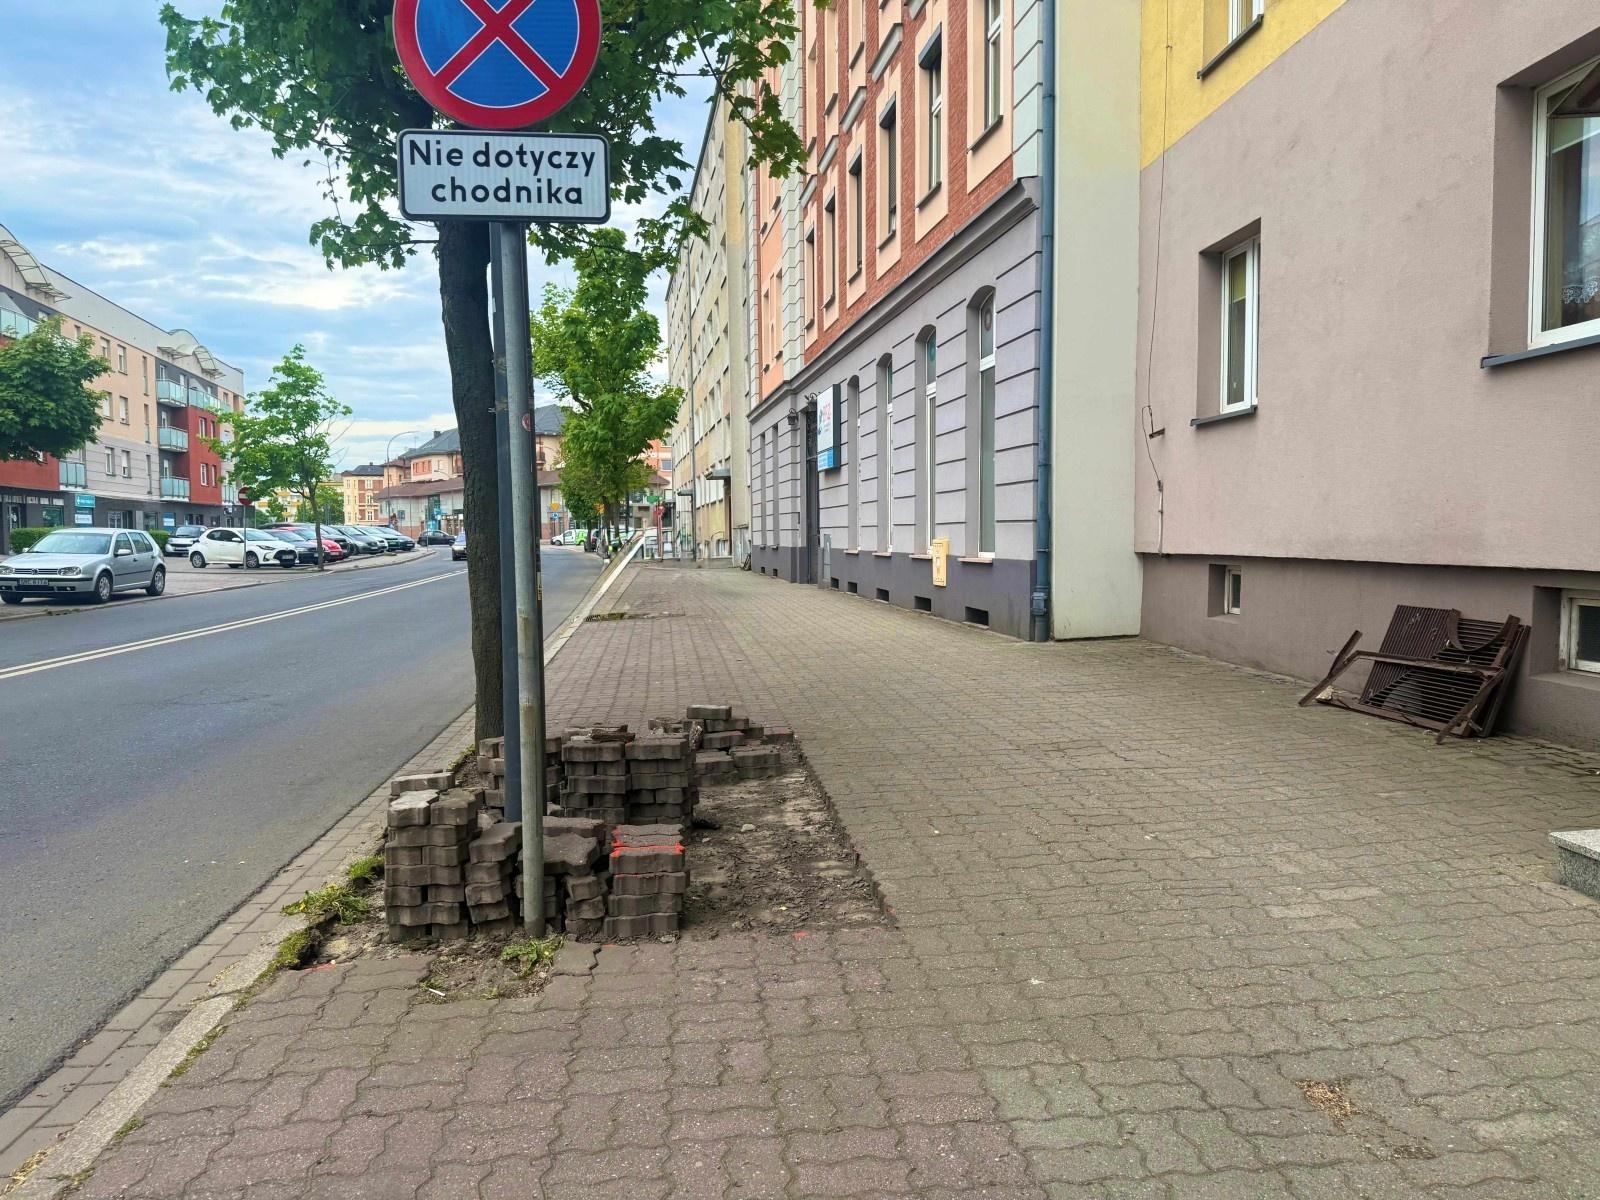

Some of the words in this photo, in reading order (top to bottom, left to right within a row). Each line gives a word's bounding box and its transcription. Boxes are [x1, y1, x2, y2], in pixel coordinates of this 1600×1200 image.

[409, 139, 464, 167] Nie
[472, 141, 596, 177] dotyczy
[431, 176, 583, 205] chodnika
